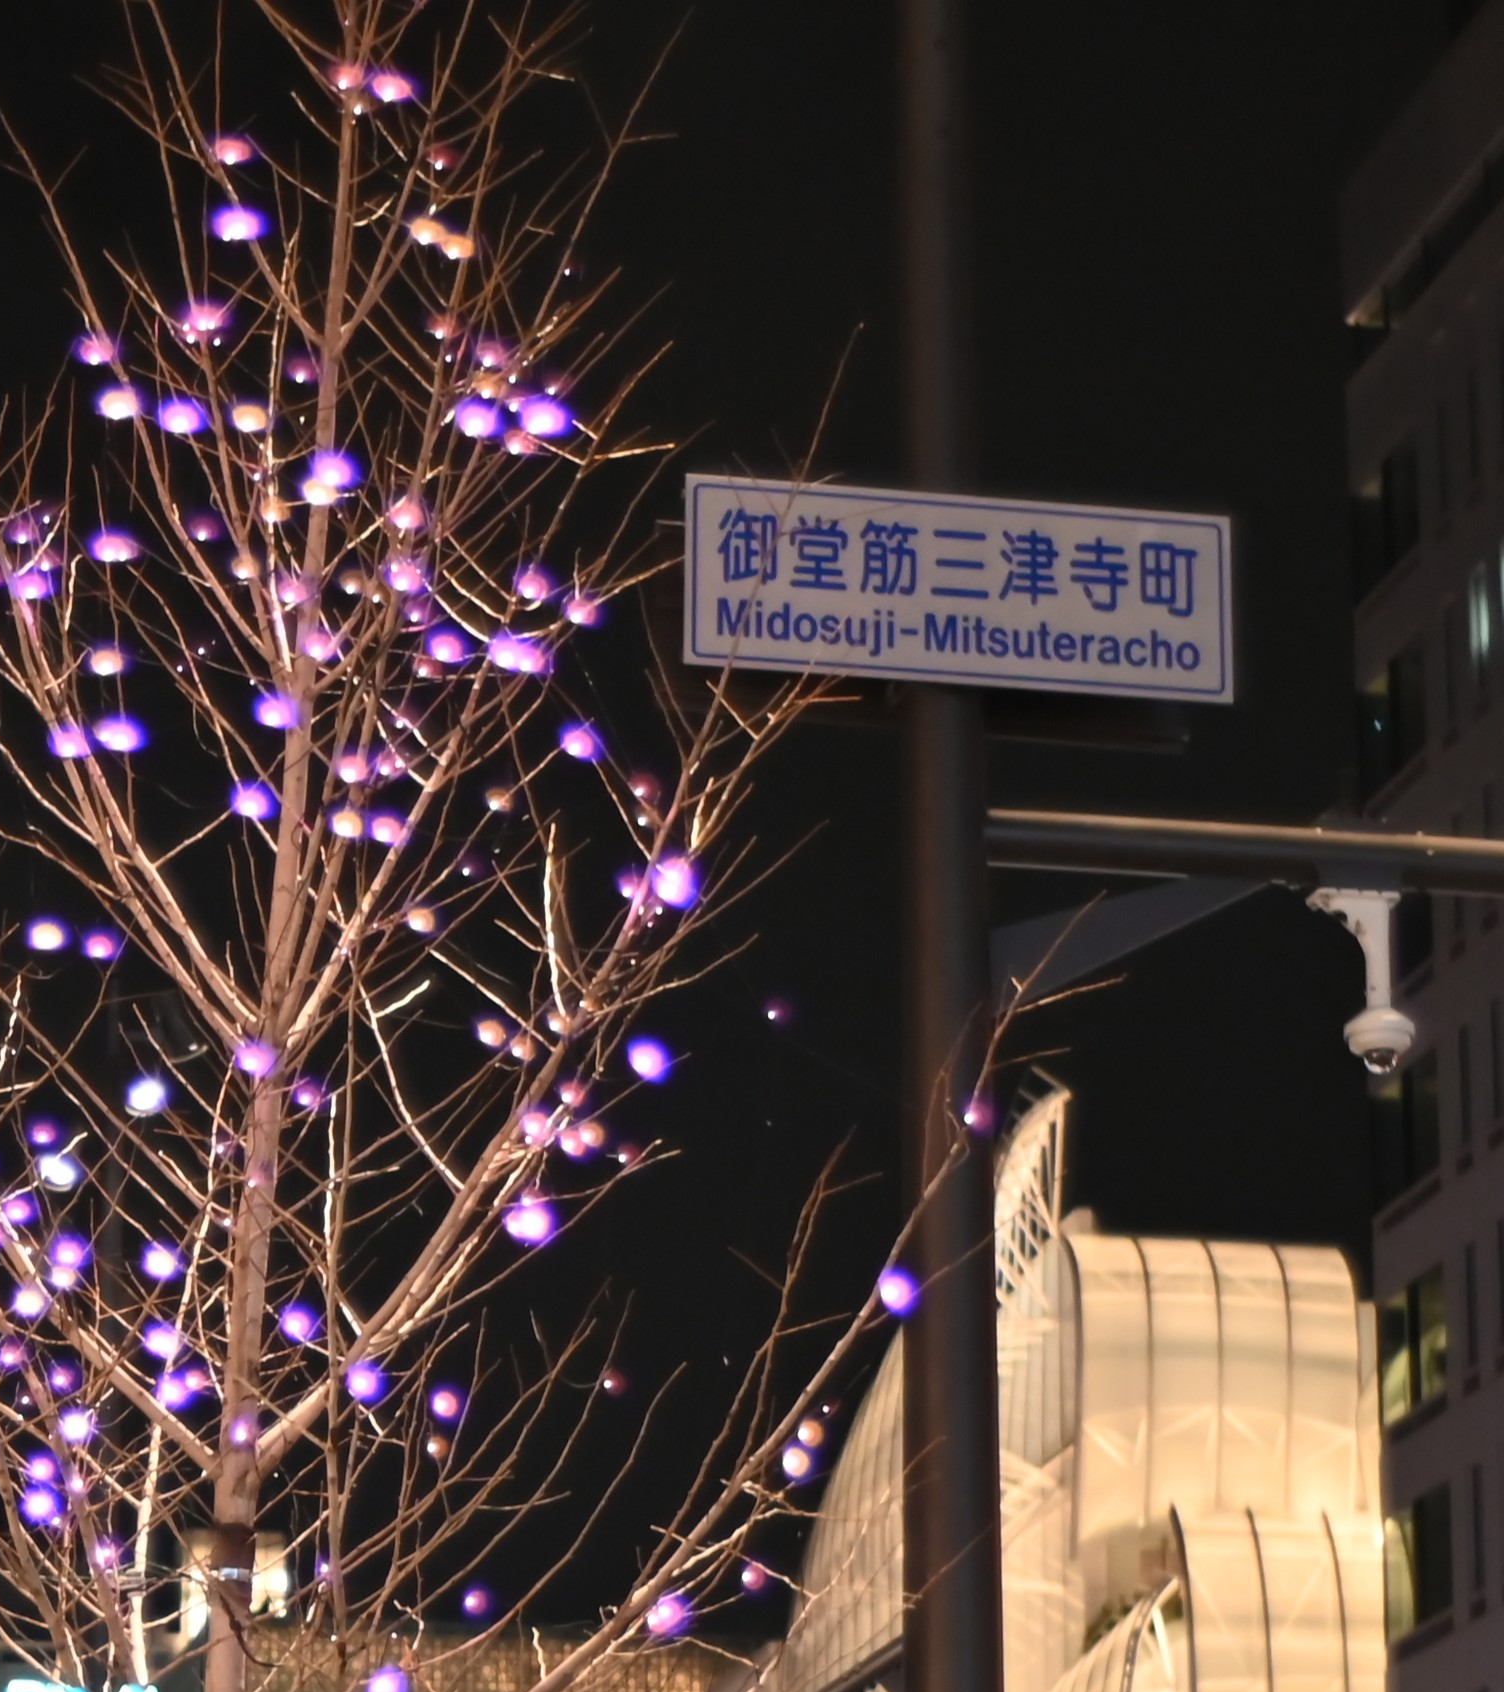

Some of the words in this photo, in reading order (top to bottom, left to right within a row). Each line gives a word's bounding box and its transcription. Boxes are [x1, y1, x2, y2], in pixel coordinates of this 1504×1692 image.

[717, 508, 1197, 618] 御堂筋三津寺町
[715, 597, 1200, 672] Midosuji-Mitsuteracho
